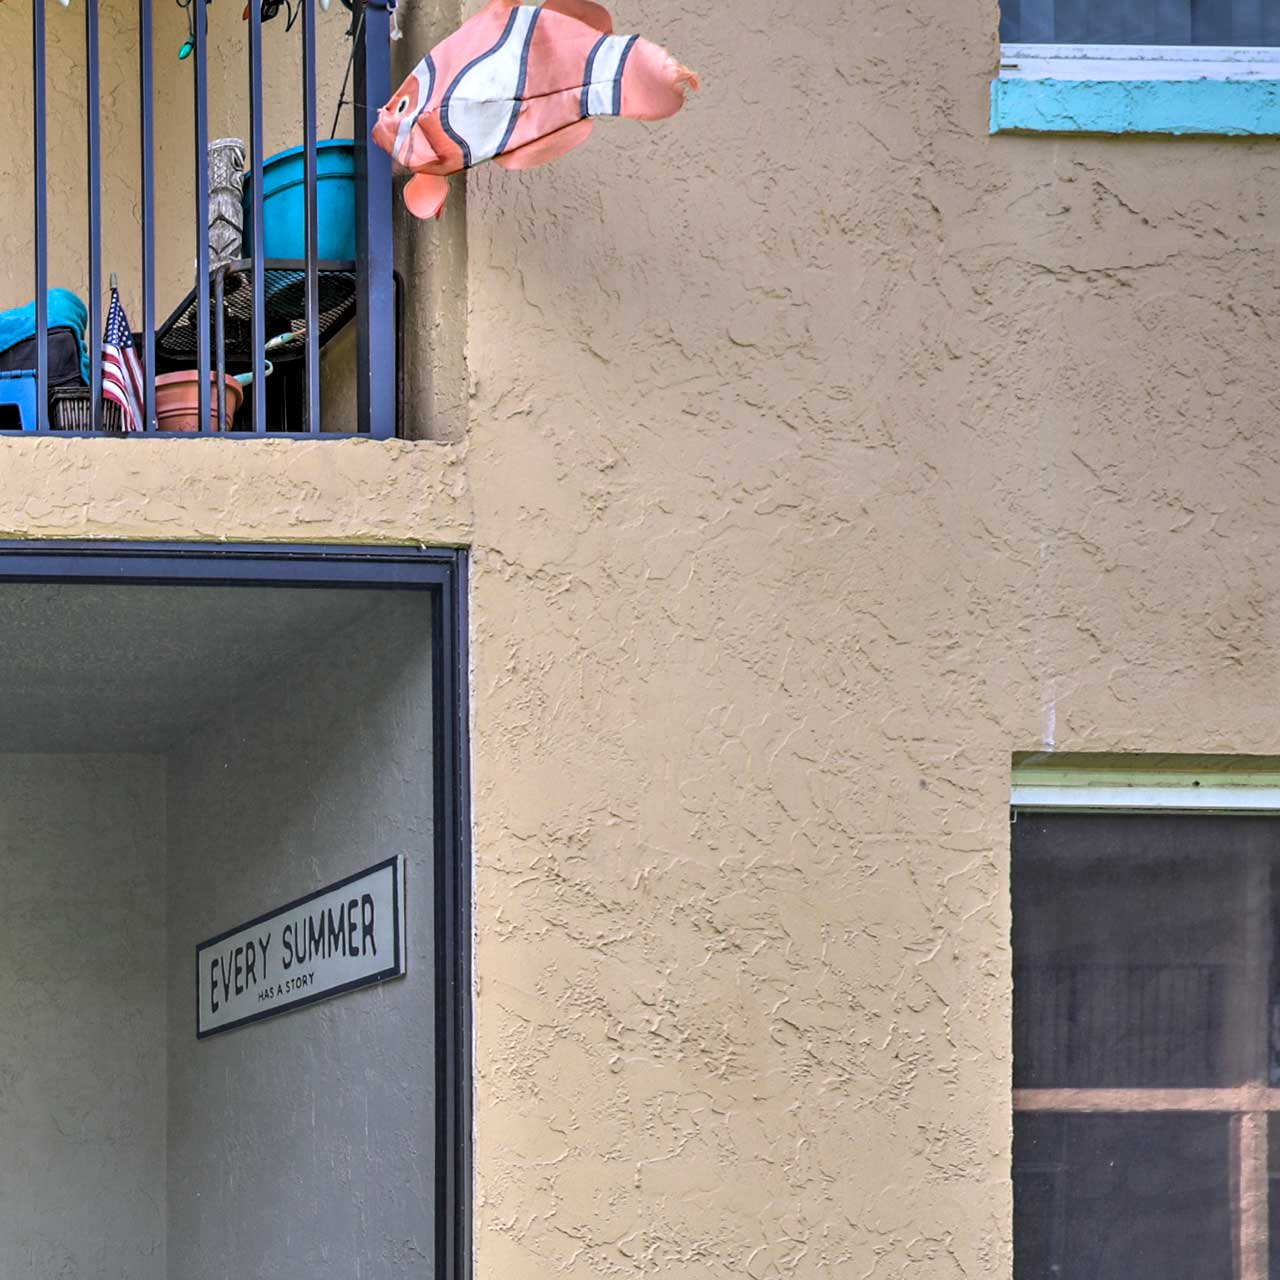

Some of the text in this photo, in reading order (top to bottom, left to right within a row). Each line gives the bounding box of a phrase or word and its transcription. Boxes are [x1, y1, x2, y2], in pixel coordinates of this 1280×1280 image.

[210, 893, 377, 1014] EVERY SUMMER
[258, 972, 315, 1002] HAS A STORY
